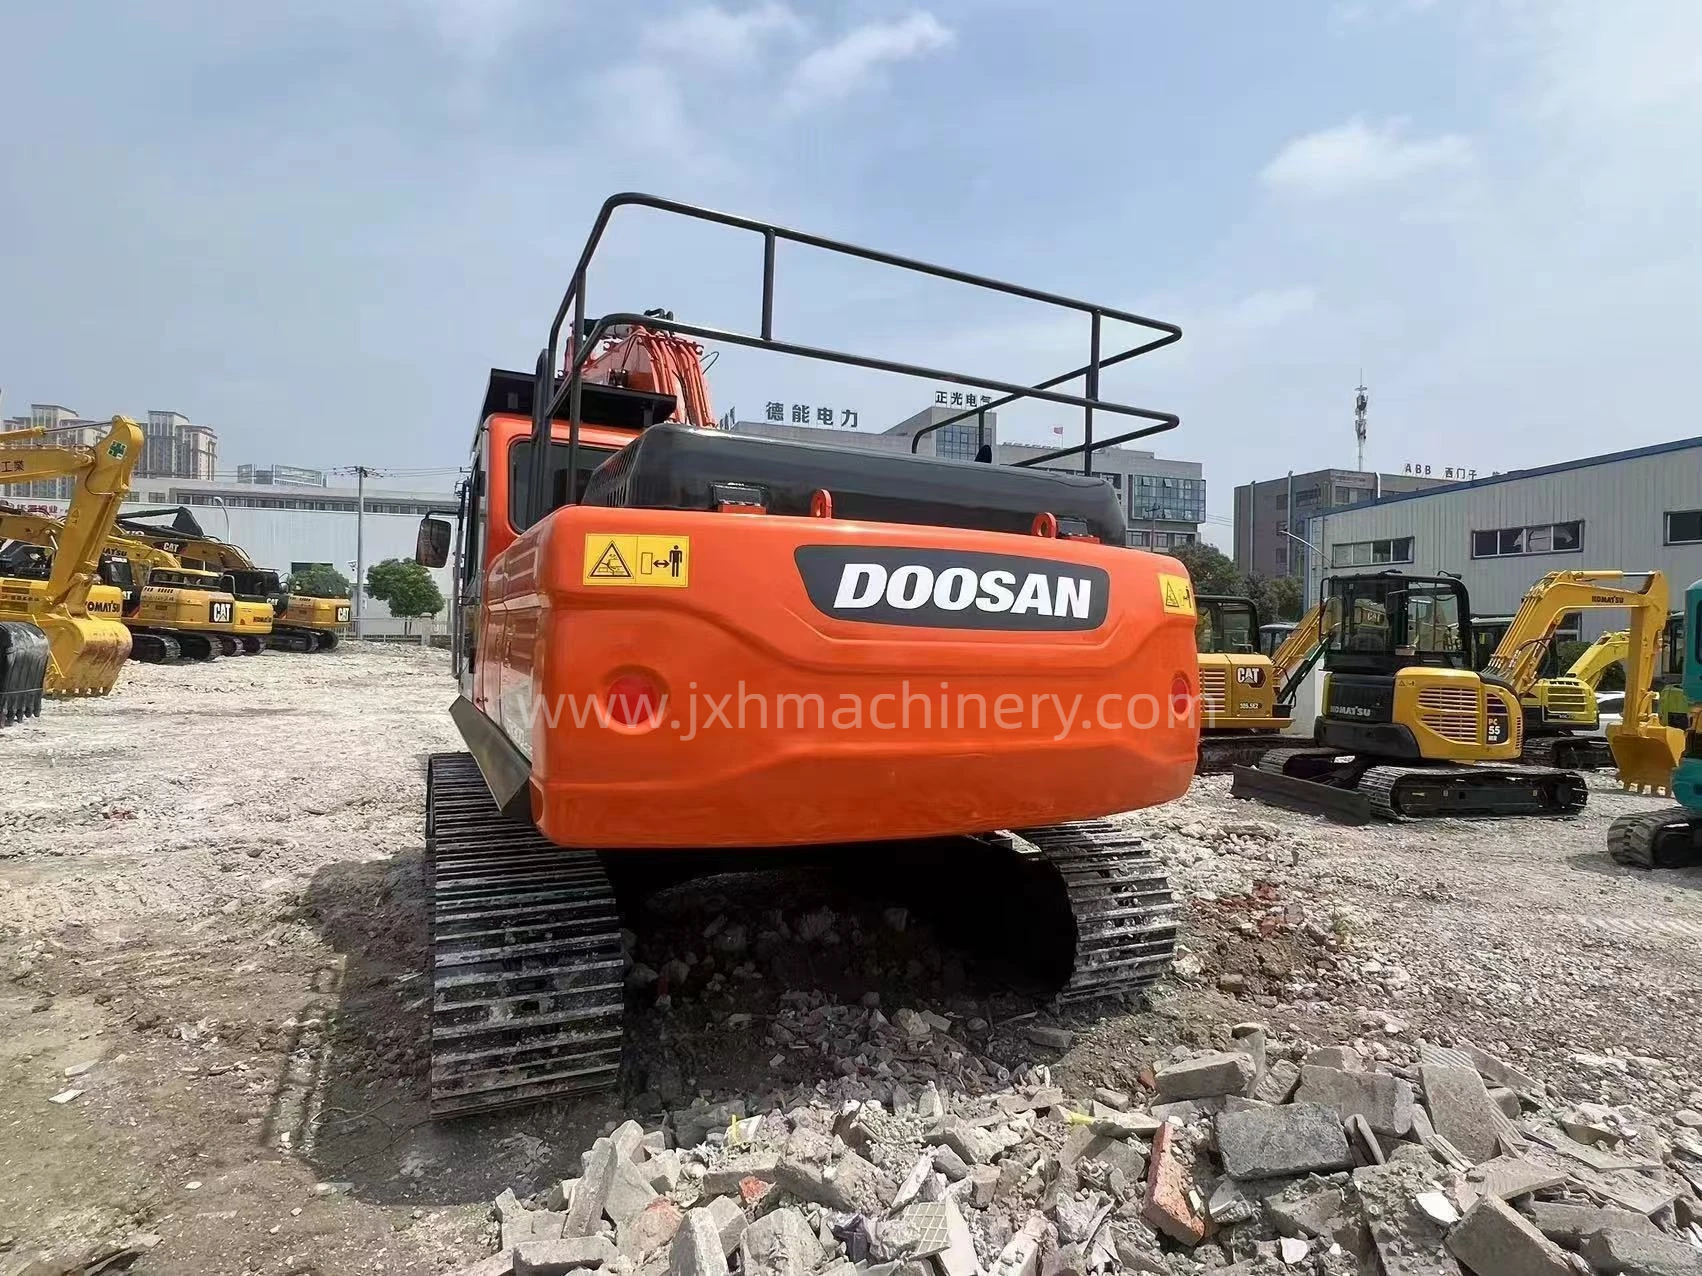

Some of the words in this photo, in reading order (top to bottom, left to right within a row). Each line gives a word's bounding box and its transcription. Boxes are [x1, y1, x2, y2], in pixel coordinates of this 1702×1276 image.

[935, 391, 992, 407] 正光电气
[765, 401, 858, 428] 德能电力
[1405, 463, 1431, 474] ABB
[1445, 467, 1477, 480] 西门子
[163, 542, 179, 552] CAT
[833, 563, 1092, 619] DOOSAN
[85, 601, 120, 612] OMATSU
[213, 602, 231, 622] CAT
[337, 607, 350, 622] CAT
[1237, 667, 1260, 683] CAT
[1330, 704, 1371, 716] KOMATSU
[1488, 726, 1501, 735] 55
